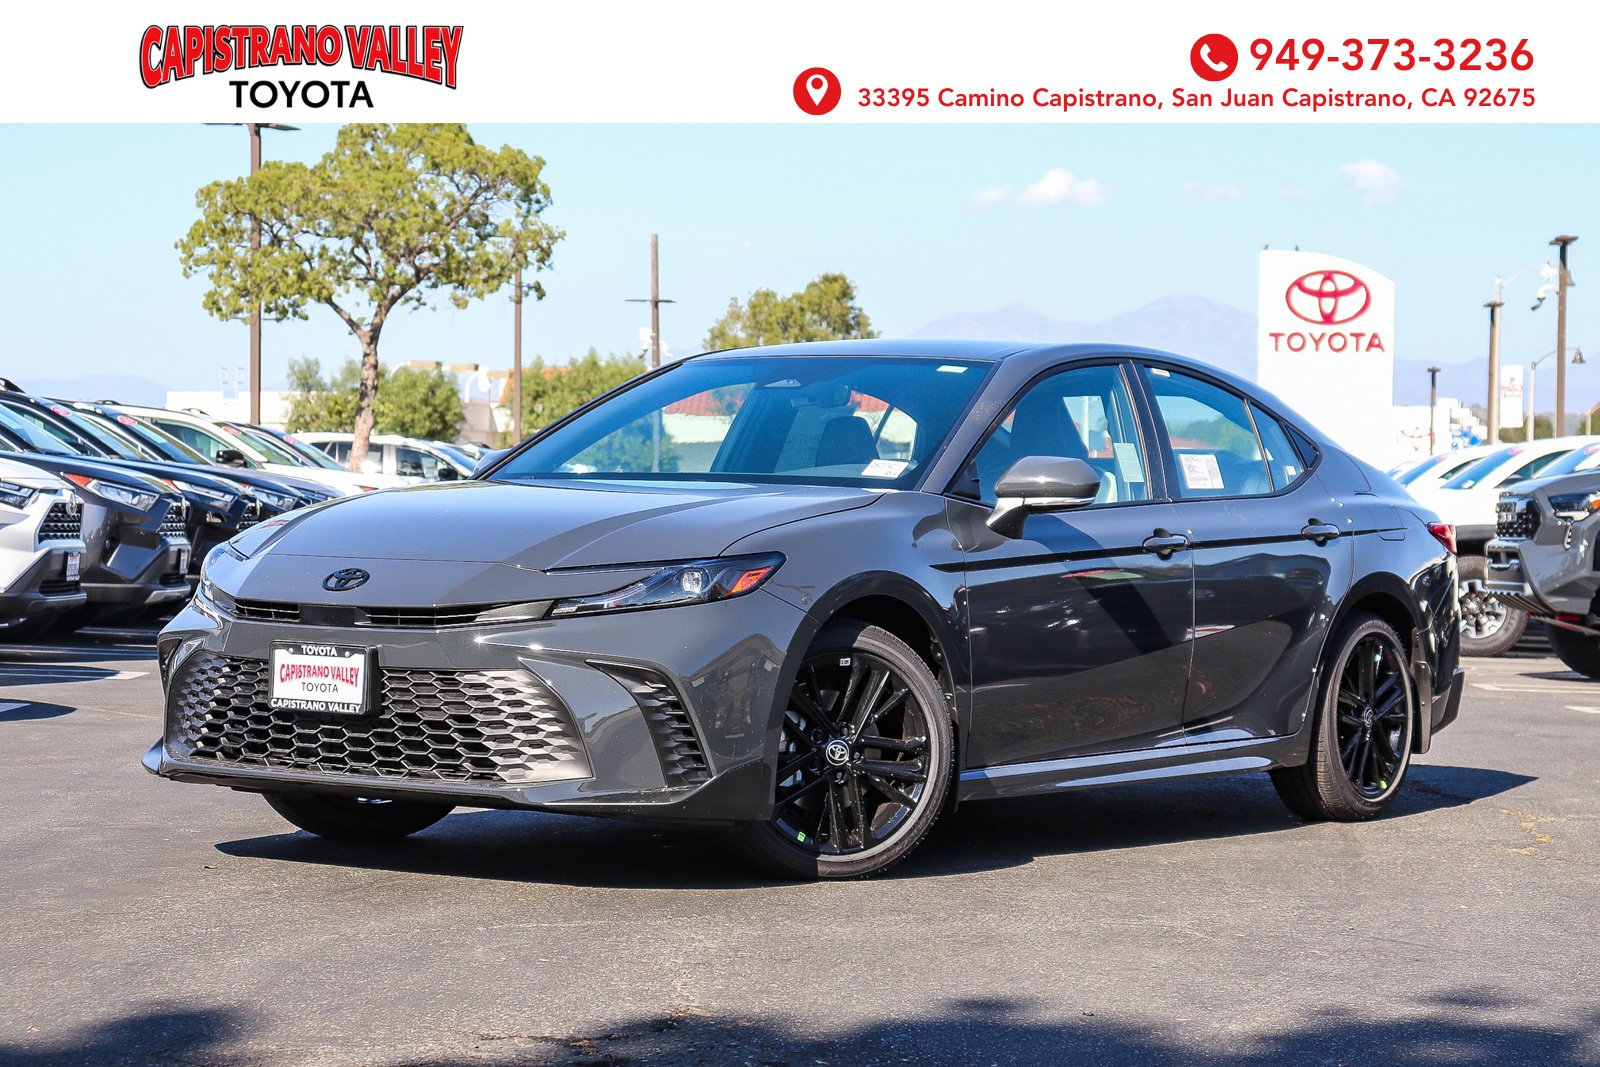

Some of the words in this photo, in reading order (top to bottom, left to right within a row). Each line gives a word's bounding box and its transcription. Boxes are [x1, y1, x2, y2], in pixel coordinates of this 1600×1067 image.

[1269, 331, 1385, 353] TOYOTA
[301, 645, 338, 657] TOYOTA
[280, 663, 330, 683] CAPISTRANO
[330, 666, 360, 688] VALLEY
[301, 681, 339, 693] TOYOTA
[270, 698, 326, 711] CAPISTRANO
[328, 702, 361, 714] VALLEY
